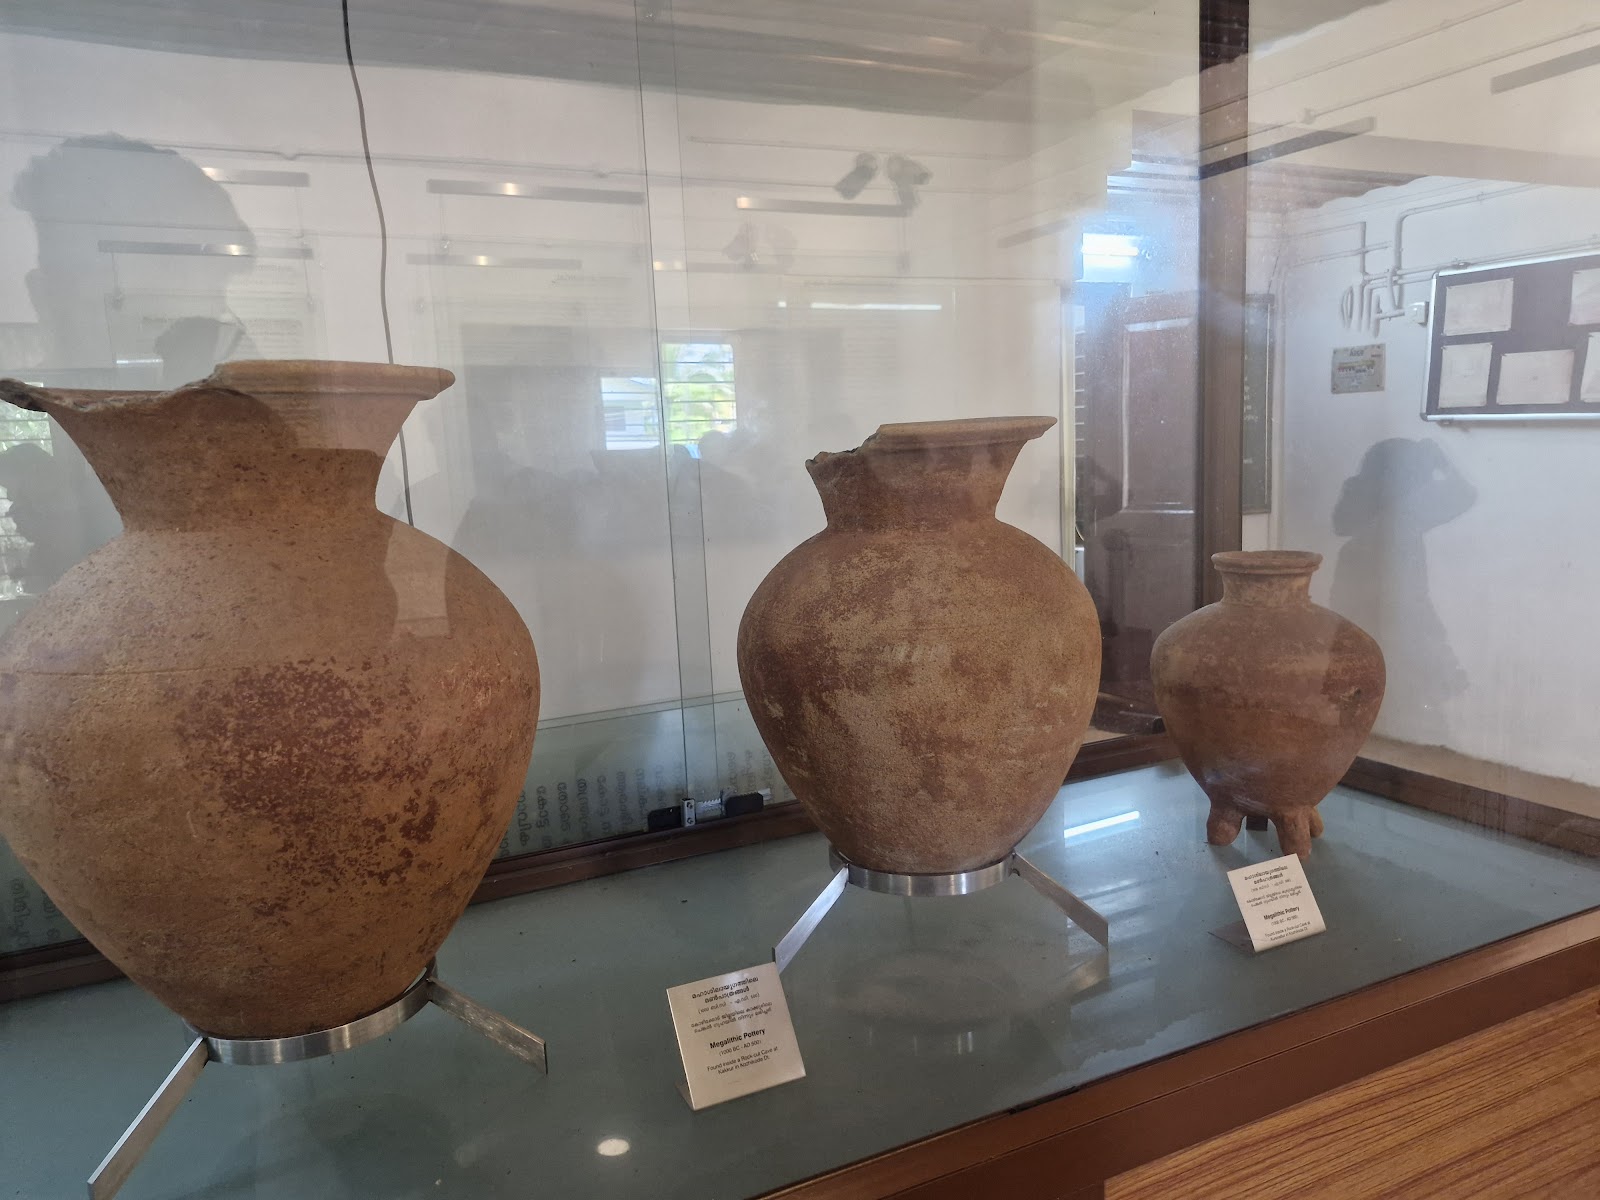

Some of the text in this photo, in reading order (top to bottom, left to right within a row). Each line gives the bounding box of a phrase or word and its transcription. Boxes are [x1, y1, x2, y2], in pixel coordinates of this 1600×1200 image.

[1264, 910, 1285, 920] Megalithic
[710, 1028, 766, 1049] Megalithic Pottery
[707, 1063, 722, 1071] Found
